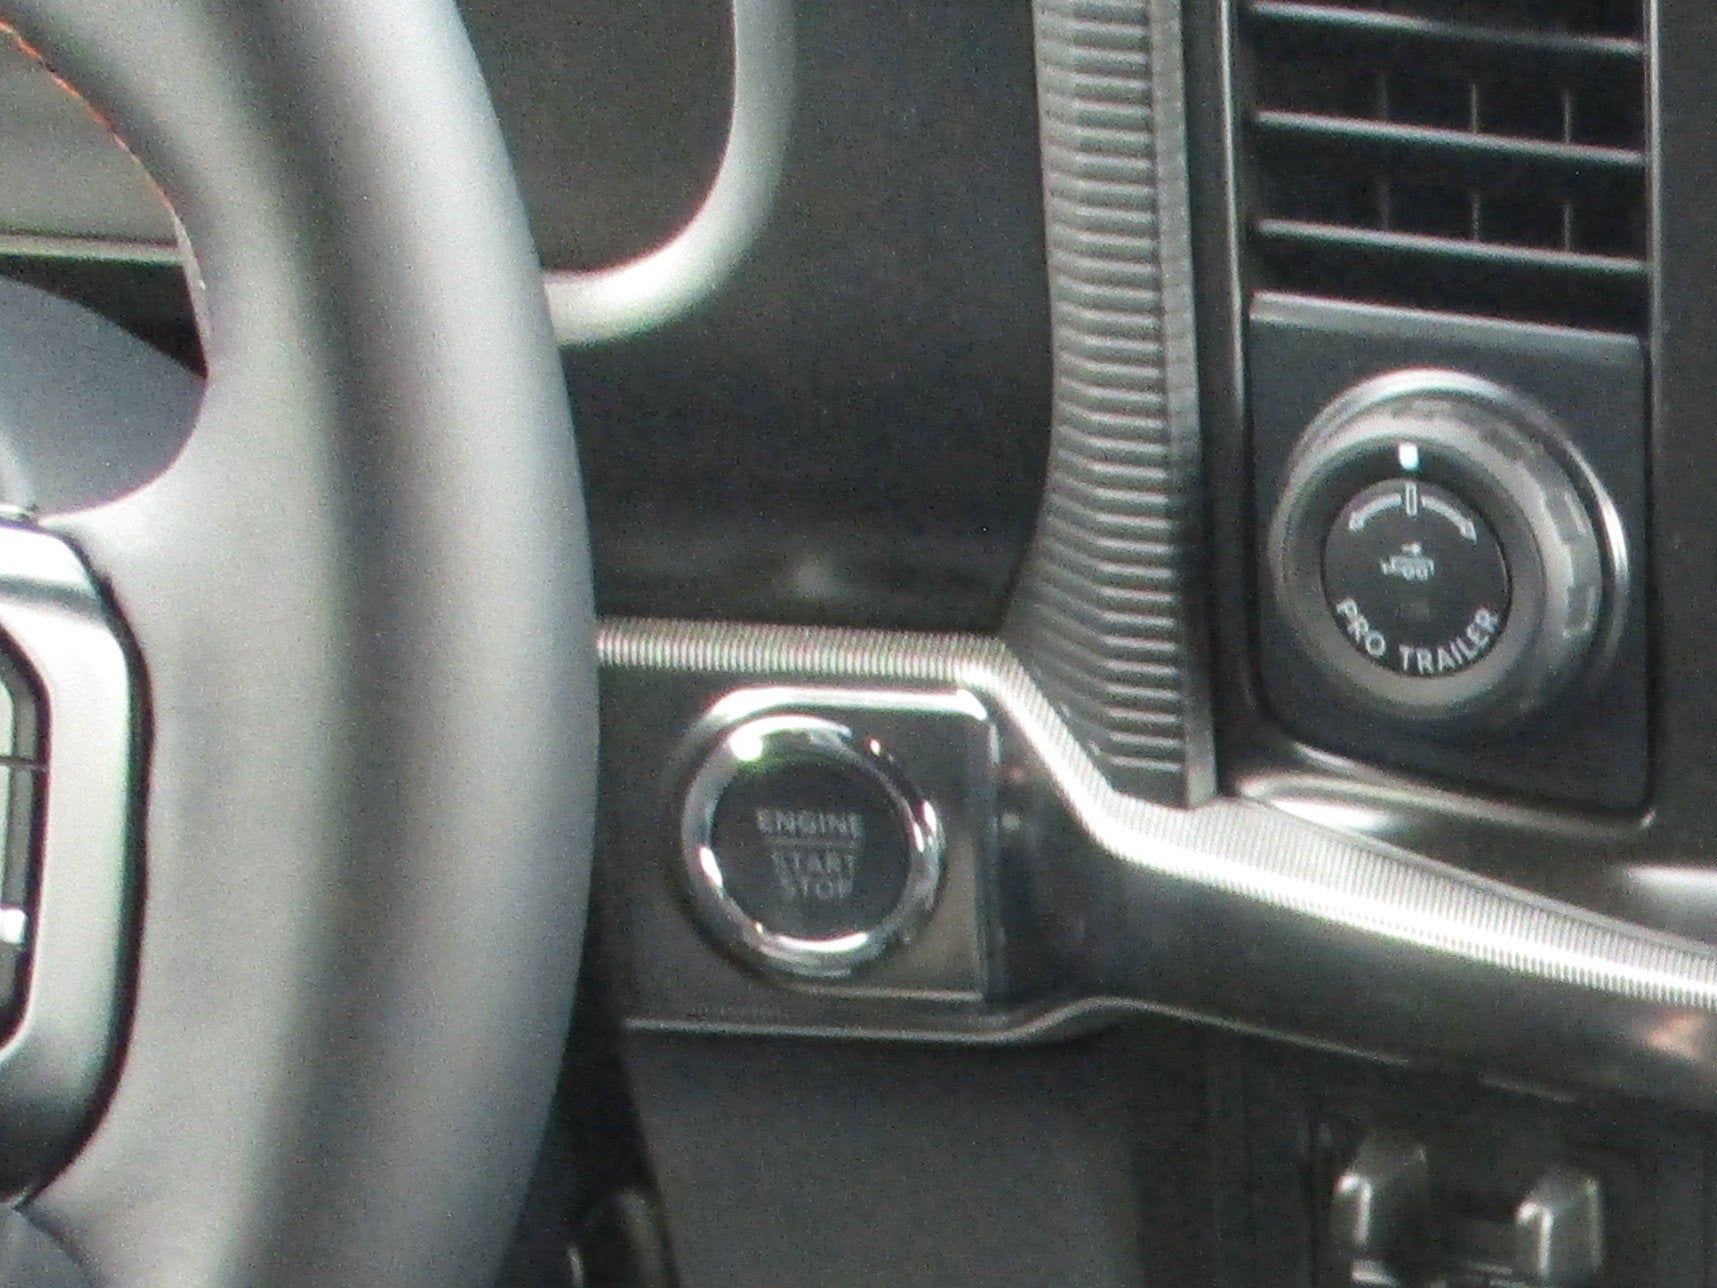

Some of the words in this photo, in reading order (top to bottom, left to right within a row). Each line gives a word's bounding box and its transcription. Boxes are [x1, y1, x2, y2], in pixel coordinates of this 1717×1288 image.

[1336, 598, 1386, 658] PRO
[1400, 606, 1500, 676] TRAILER
[756, 808, 864, 840] ENGINE
